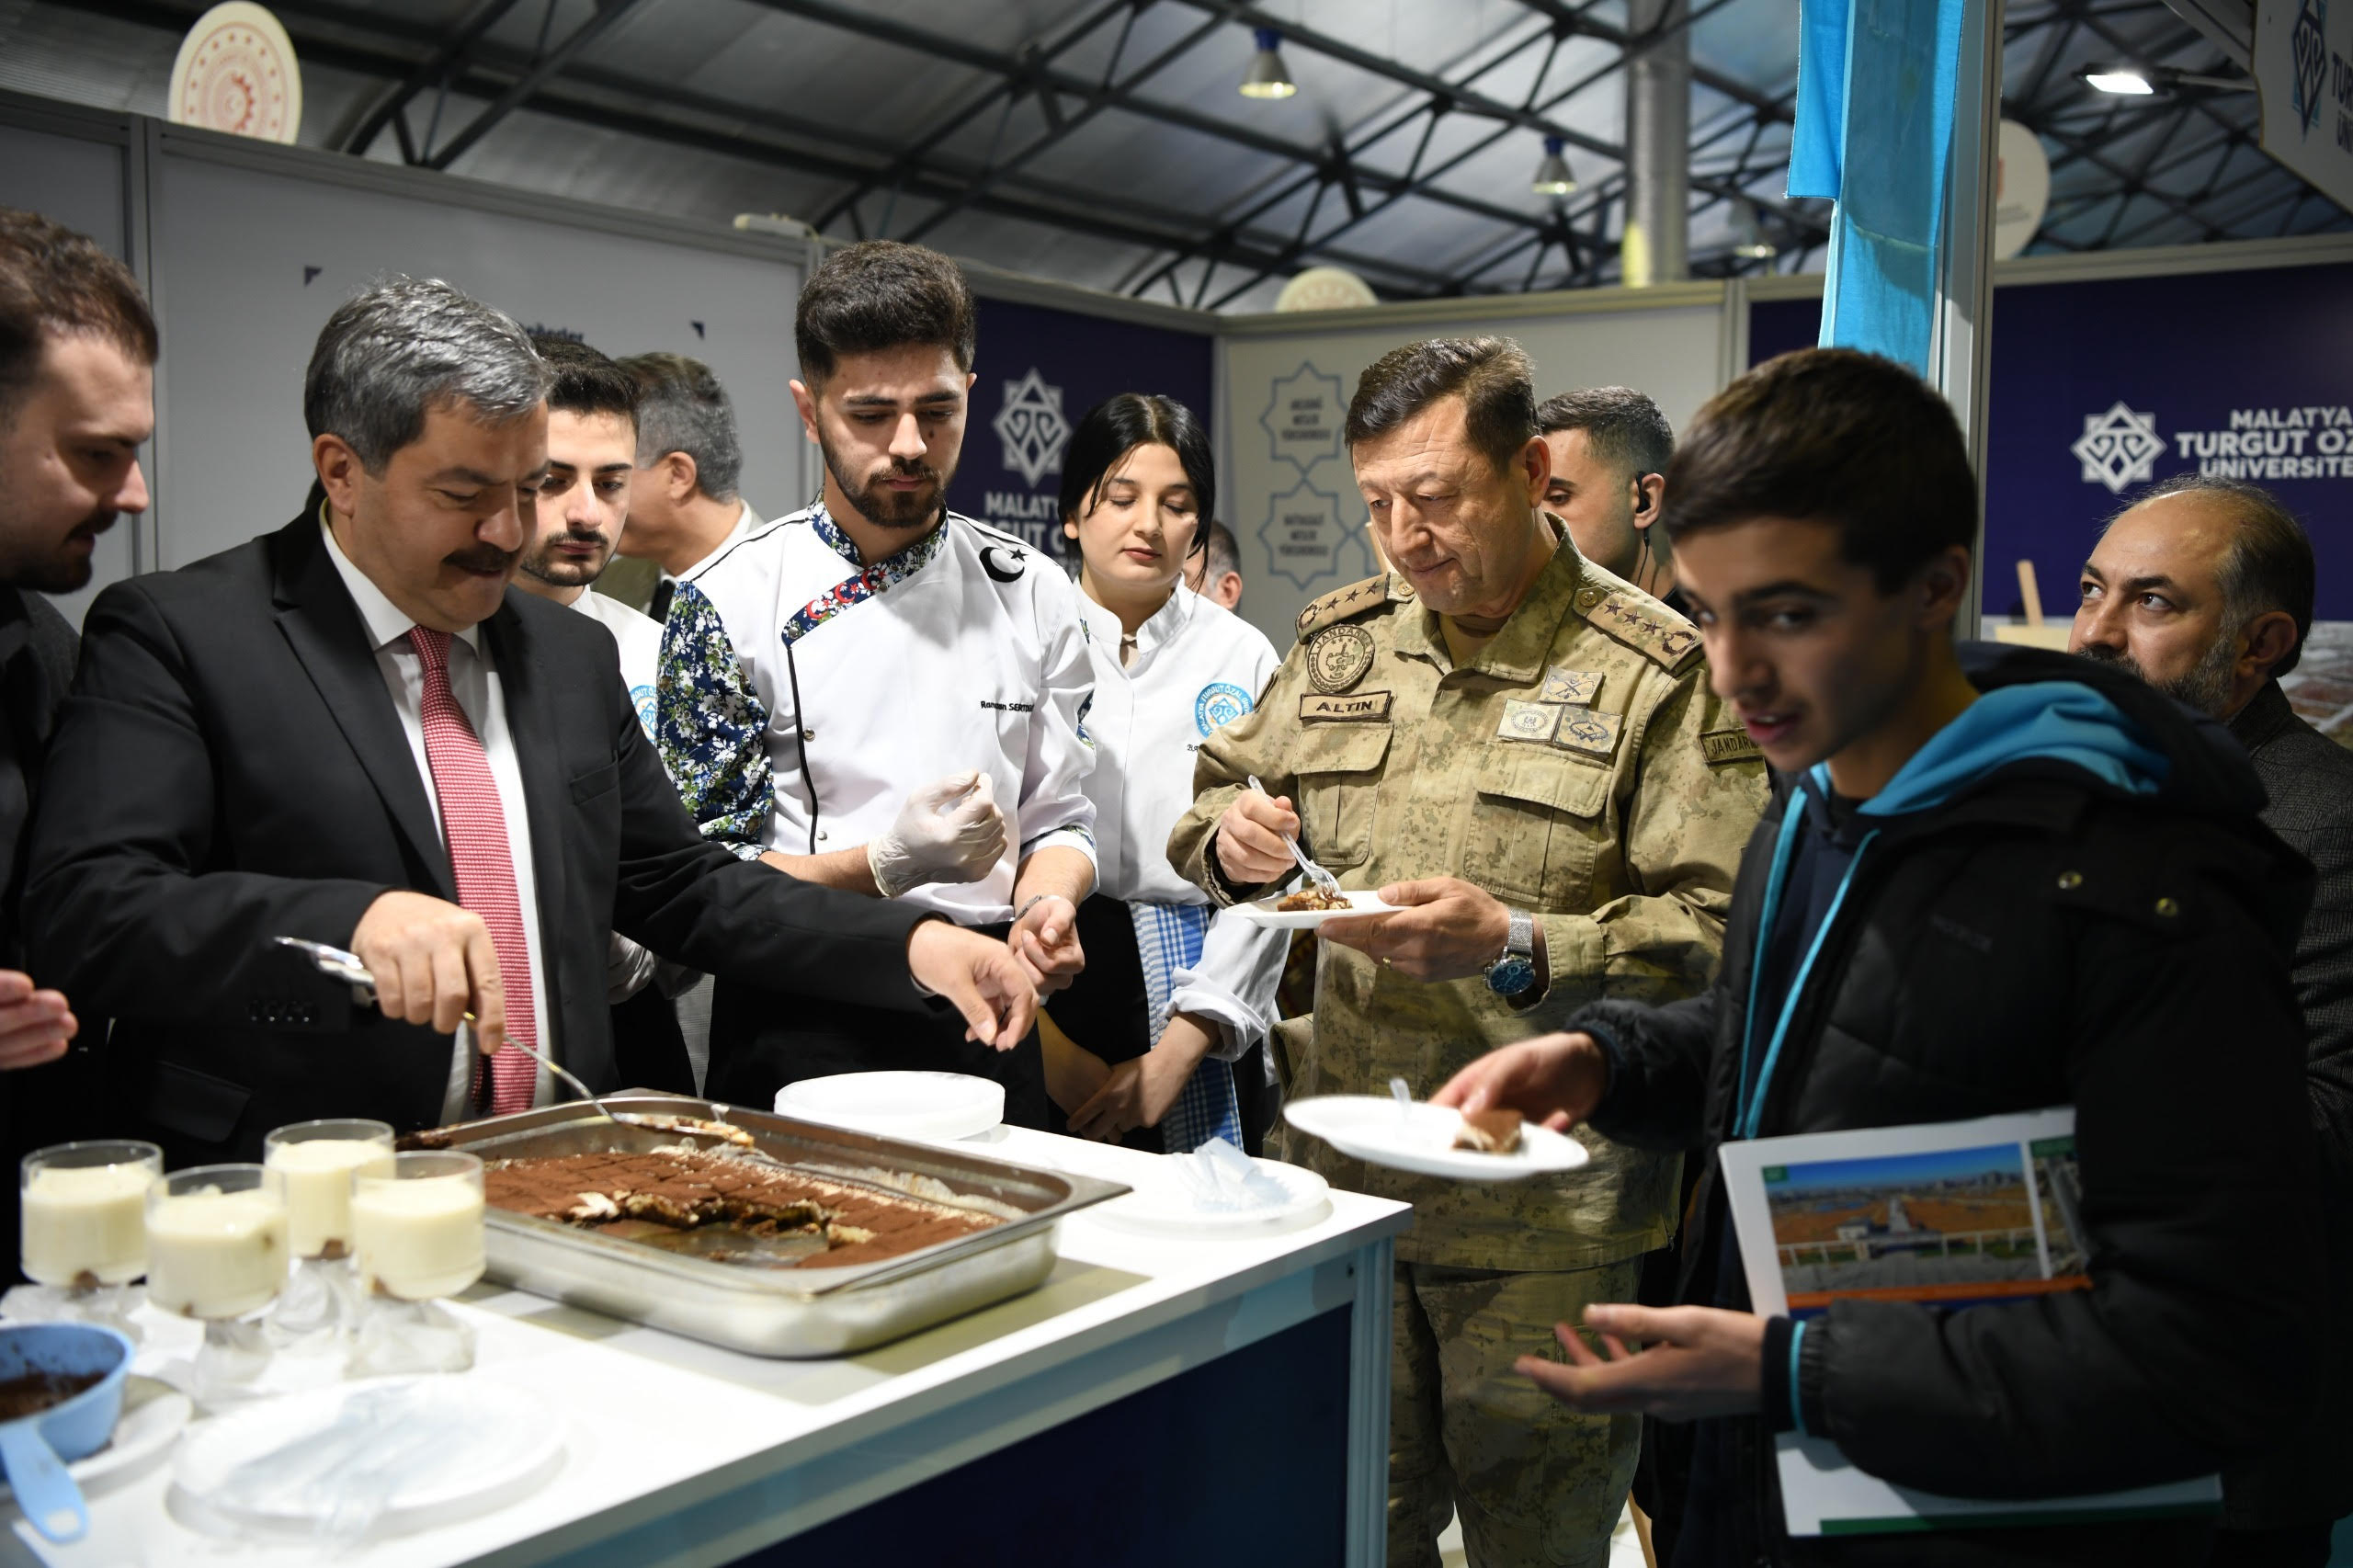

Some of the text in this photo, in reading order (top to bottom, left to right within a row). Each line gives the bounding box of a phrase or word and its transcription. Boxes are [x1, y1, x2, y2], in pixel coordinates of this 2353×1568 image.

[2230, 406, 2353, 429] MALATYA
[2175, 430, 2310, 459] TURGUT
[1316, 700, 1373, 713] ALTIN
